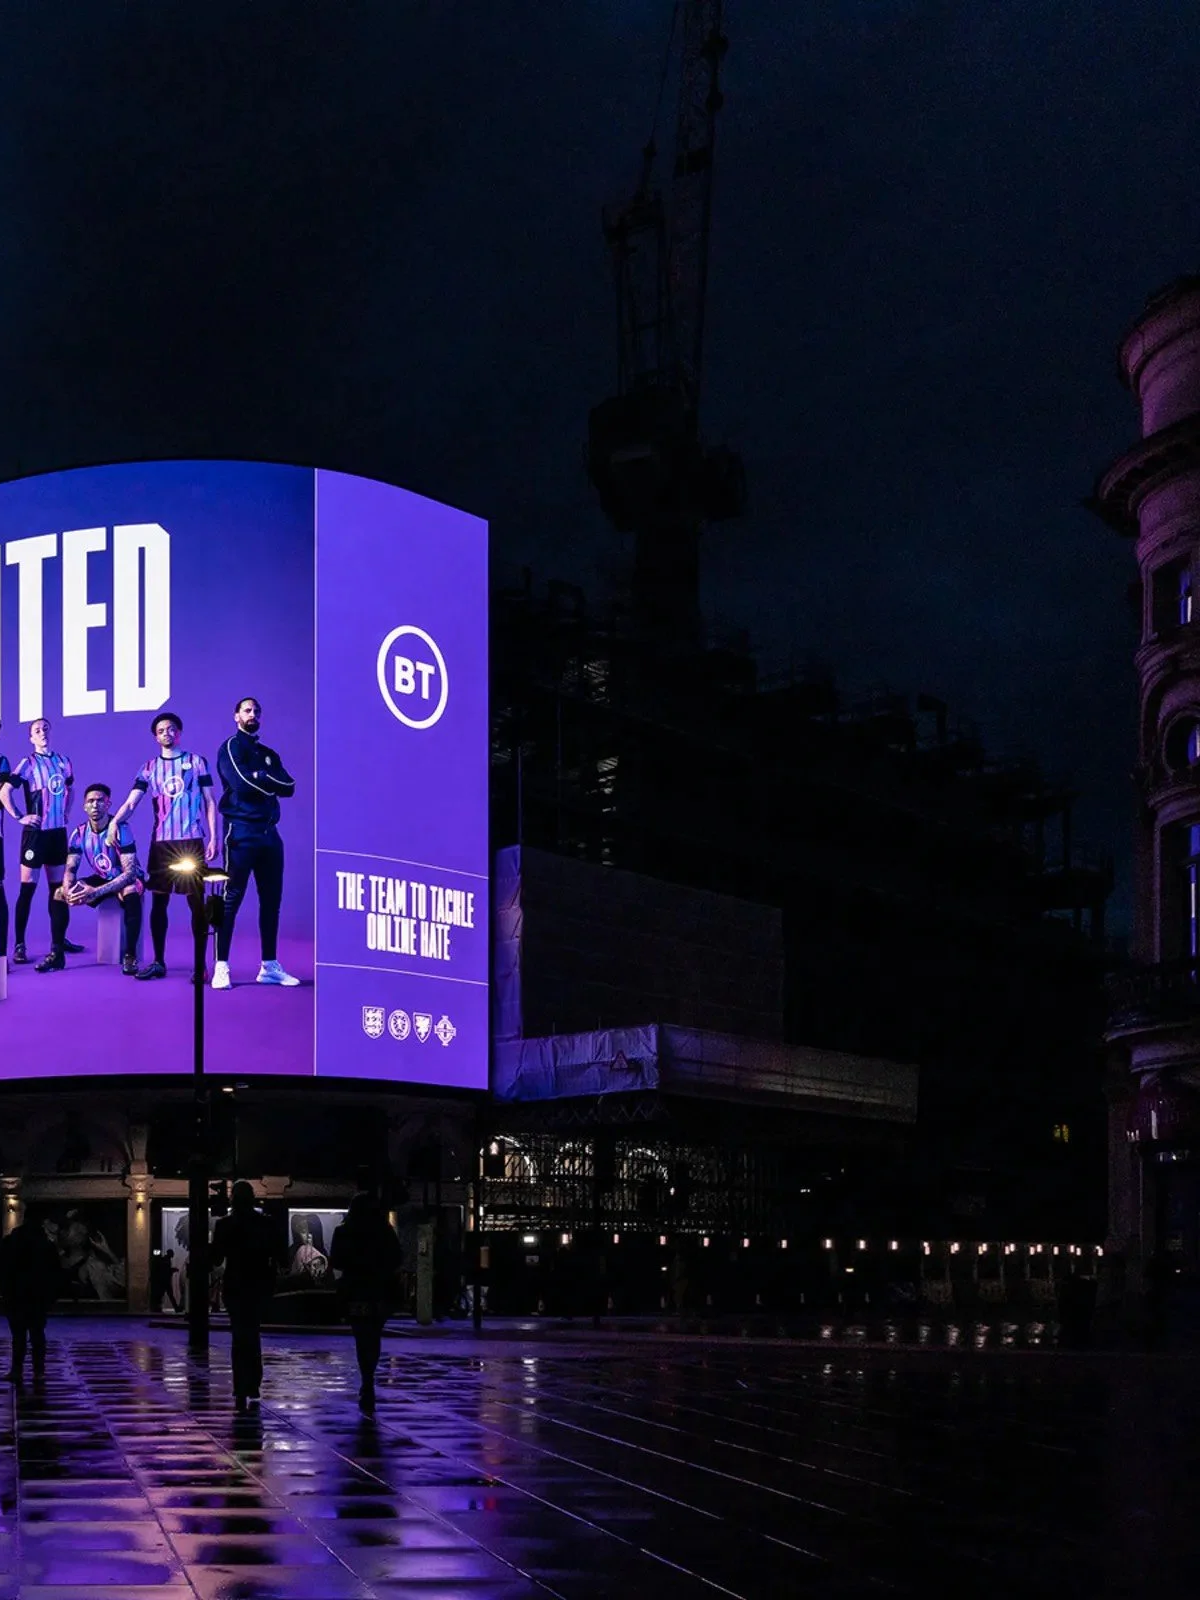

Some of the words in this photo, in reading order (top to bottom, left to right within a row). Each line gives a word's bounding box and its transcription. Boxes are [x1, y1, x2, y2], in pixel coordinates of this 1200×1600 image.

[395, 655, 435, 700] BT
[336, 871, 365, 911] THE
[368, 875, 407, 917] TEAM
[410, 881, 427, 920] TO
[429, 885, 474, 928] TACKLE
[366, 912, 417, 955] ONLINE
[420, 920, 450, 961] HATE
